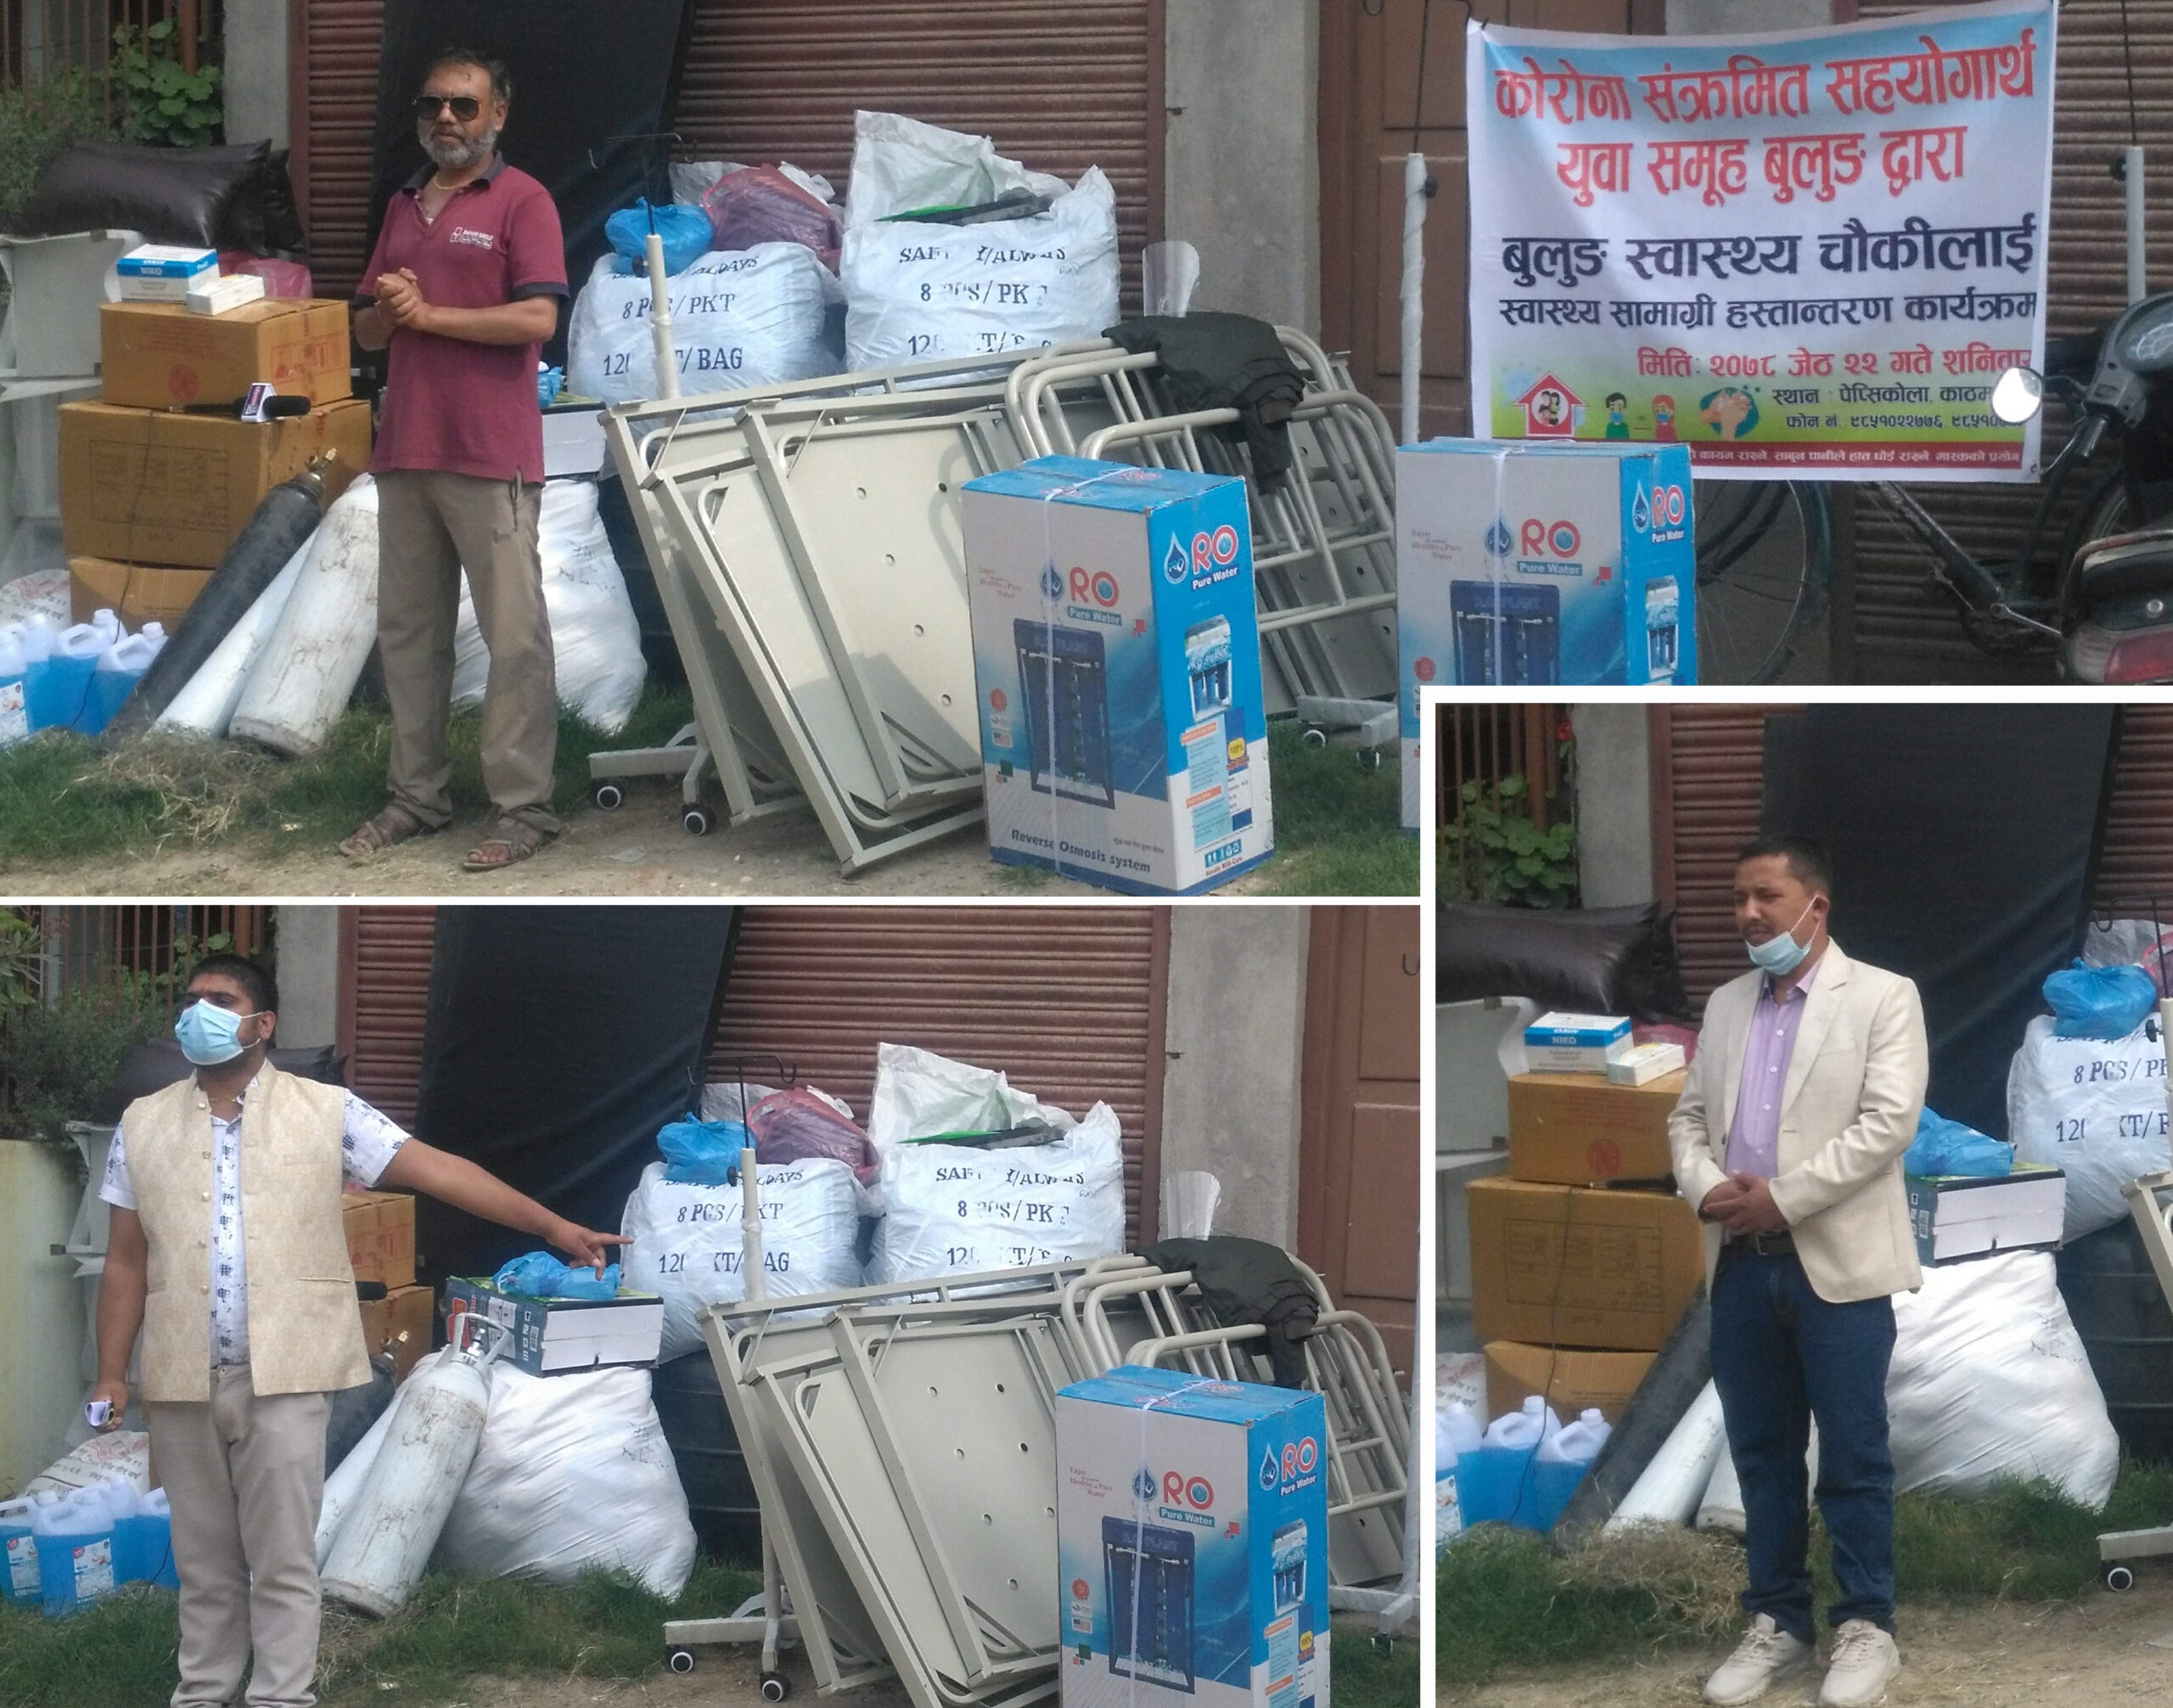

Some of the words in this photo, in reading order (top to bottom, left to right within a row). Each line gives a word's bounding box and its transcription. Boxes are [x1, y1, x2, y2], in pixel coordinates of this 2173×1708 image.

[1495, 56, 1632, 125] कोरोना
[1638, 54, 1811, 123] संक्रमित
[1825, 27, 2036, 115] सहयोगार्थ
[1557, 143, 1633, 207] युवा
[1647, 138, 1749, 207] समूह
[1763, 132, 1867, 204] बुलुङ
[1879, 126, 1968, 198] द्वारा
[1502, 237, 1609, 287] बुलुङ
[1626, 236, 1802, 280] स्वास्थ्य
[1817, 212, 2036, 274] चौकीलाई
[920, 283, 931, 302] 8
[622, 301, 633, 319] 8
[636, 294, 735, 318] PS/PKT
[1499, 299, 1602, 326] स्वास्थ्य
[1609, 293, 1717, 330] सामाग्री
[1726, 297, 1895, 329] हस्तान्तरण
[1904, 286, 2037, 321] कार्यक्रम
[1709, 353, 1776, 377] २०७८
[1788, 346, 1835, 377] जेठ
[1844, 352, 1878, 375] २२
[1889, 343, 1933, 374] गते
[1772, 388, 1819, 406] स्थान
[1940, 386, 1993, 403] काठम
[1786, 413, 1819, 428] फोन
[1652, 485, 1684, 528] RO
[1521, 519, 1581, 558] RO
[1653, 532, 1665, 543] Pure
[1666, 530, 1684, 541] Water
[1192, 525, 1238, 574] RO
[1193, 576, 1210, 590] Pure
[1212, 566, 1238, 587] Water
[1519, 563, 1546, 574] Pure
[1548, 565, 1581, 576] Water
[1069, 566, 1120, 607] RO
[1070, 607, 1091, 621] Pure
[1093, 611, 1121, 626] Water
[1012, 829, 1054, 849] Reverse
[1059, 841, 1106, 862] Osmosis
[1109, 855, 1151, 873] system
[1553, 1036, 1576, 1045] NIKO
[2074, 1065, 2085, 1084] 8
[2089, 1058, 2168, 1082] PCS/P
[677, 1205, 688, 1223] 8
[691, 1202, 783, 1223] PCS/KT
[957, 1200, 968, 1218] 8
[1282, 1436, 1317, 1482] RO
[1163, 1471, 1214, 1510] RO
[1280, 1485, 1295, 1497] Pure
[1295, 1475, 1317, 1492] Water
[1160, 1508, 1183, 1521] Pure
[1185, 1513, 1214, 1526] Water
